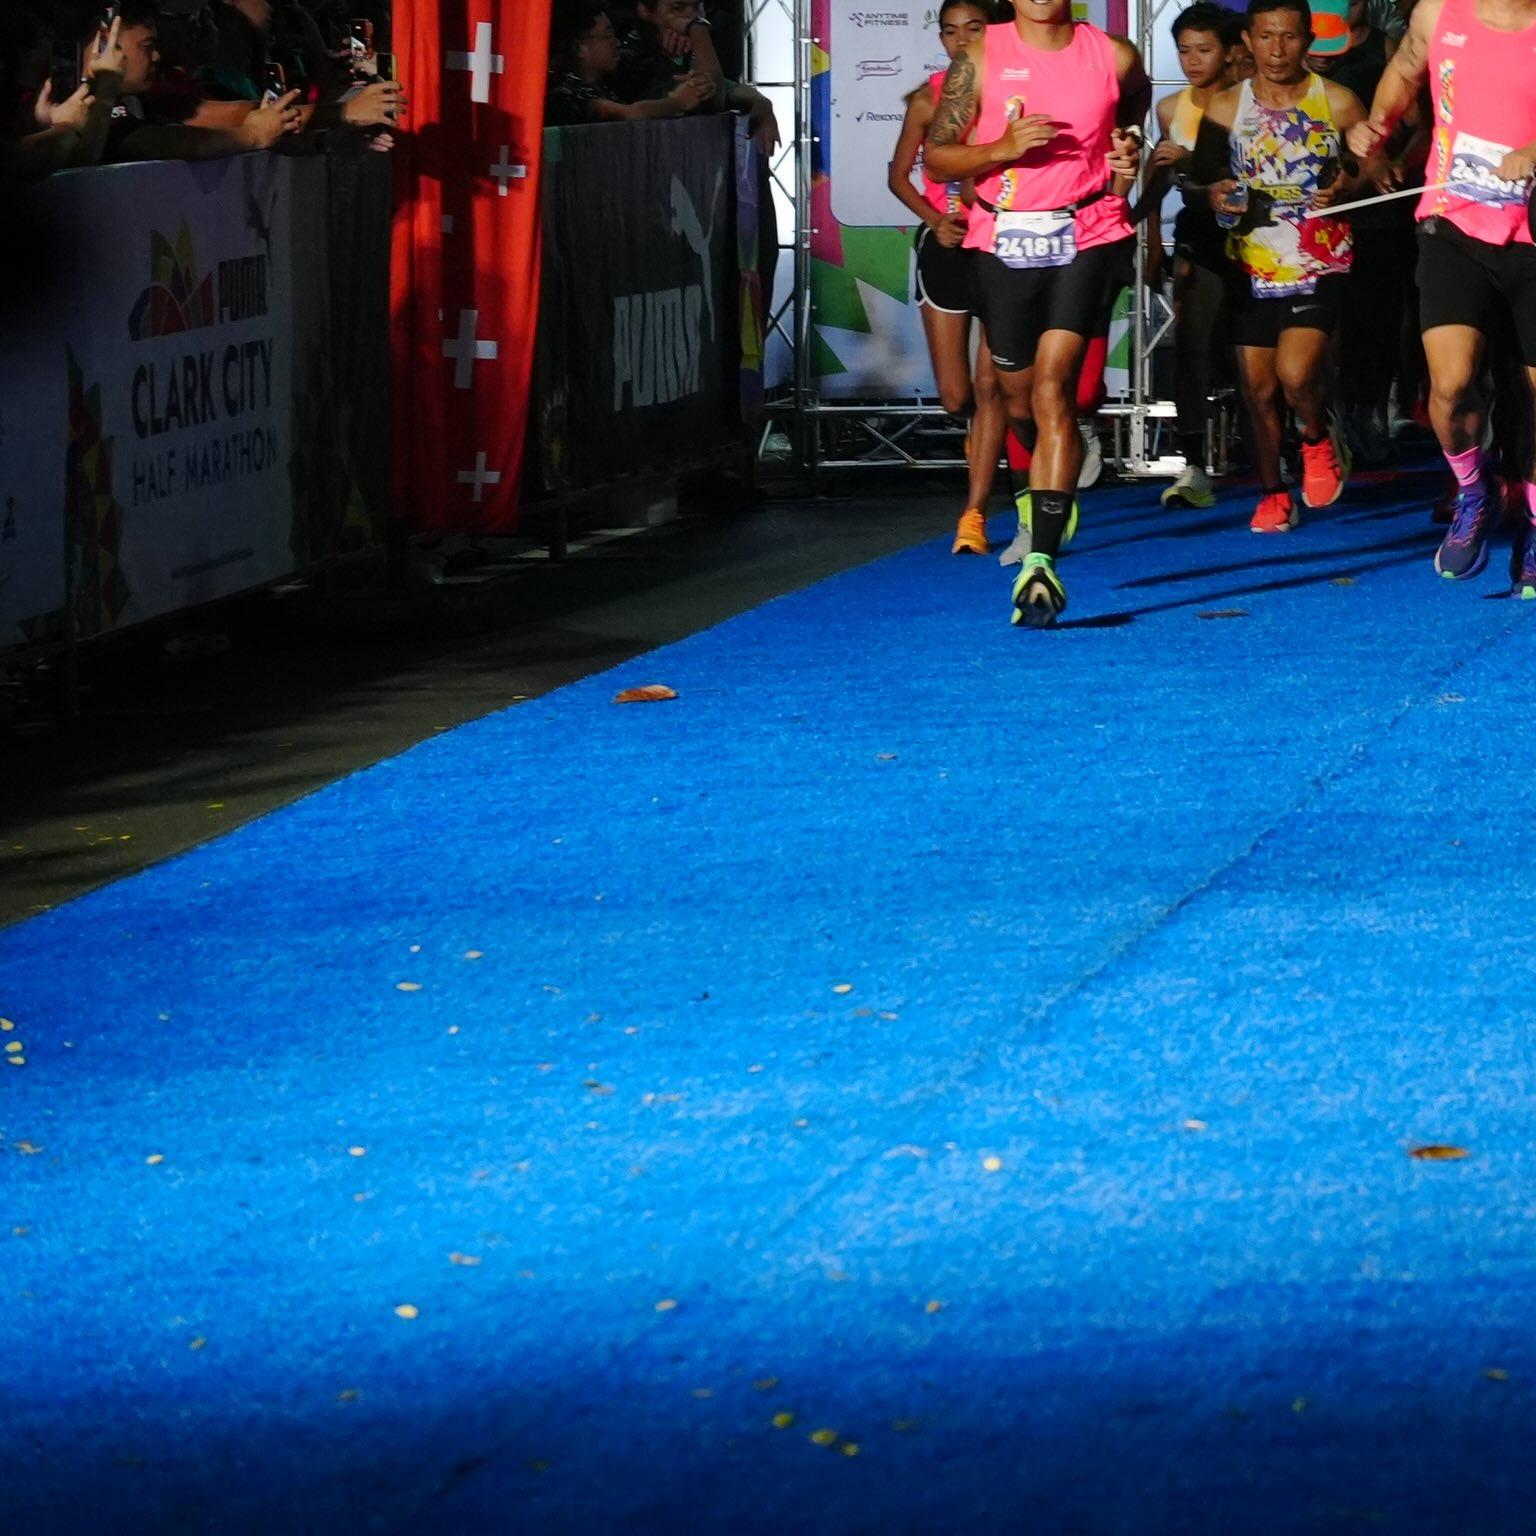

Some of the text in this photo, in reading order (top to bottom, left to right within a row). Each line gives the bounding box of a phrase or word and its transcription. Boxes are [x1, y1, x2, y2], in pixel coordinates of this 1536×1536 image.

[865, 12, 909, 20] ANYTIME
[996, 237, 1061, 257] 24181
[217, 253, 268, 326] PUMA
[613, 283, 703, 412] PUMA
[131, 337, 274, 440] CLARK CITY
[132, 428, 277, 507] HALF MARATHON
